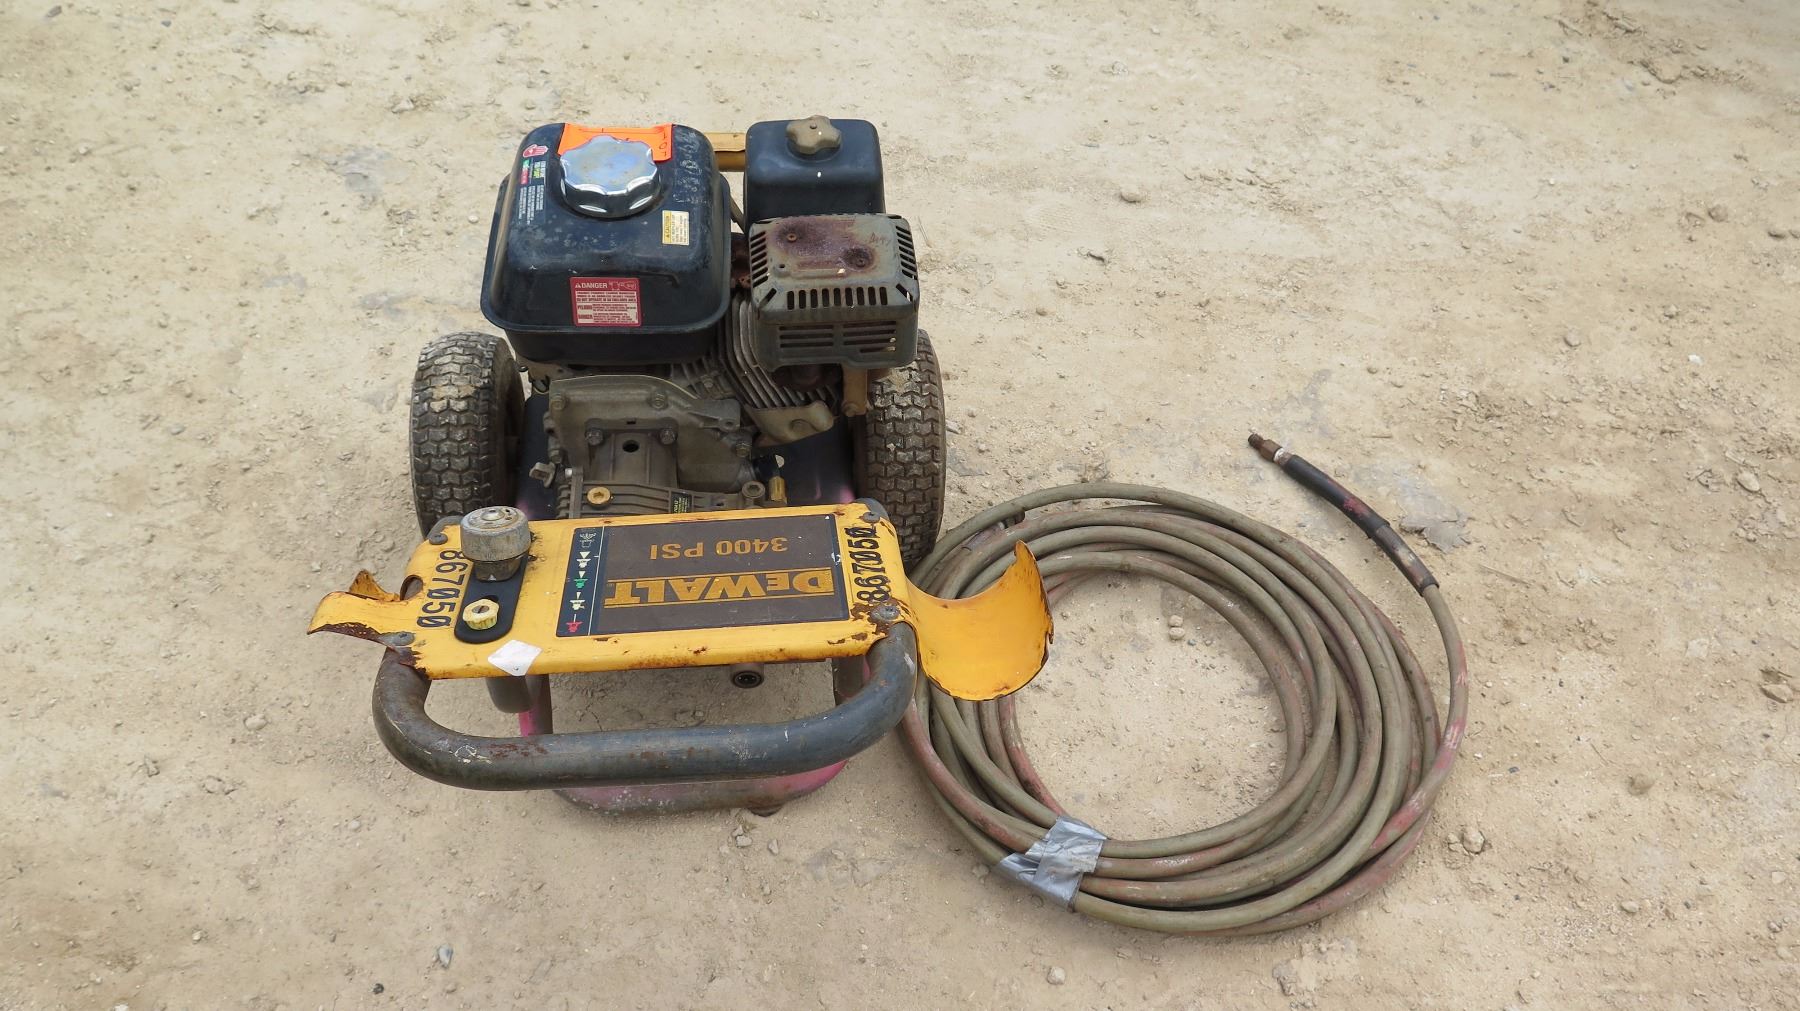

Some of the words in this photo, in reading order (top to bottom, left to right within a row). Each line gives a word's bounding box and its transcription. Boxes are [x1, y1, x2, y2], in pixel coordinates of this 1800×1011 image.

[650, 542, 704, 560] PSI
[715, 537, 788, 556] 3400
[604, 568, 834, 606] DEWALT
